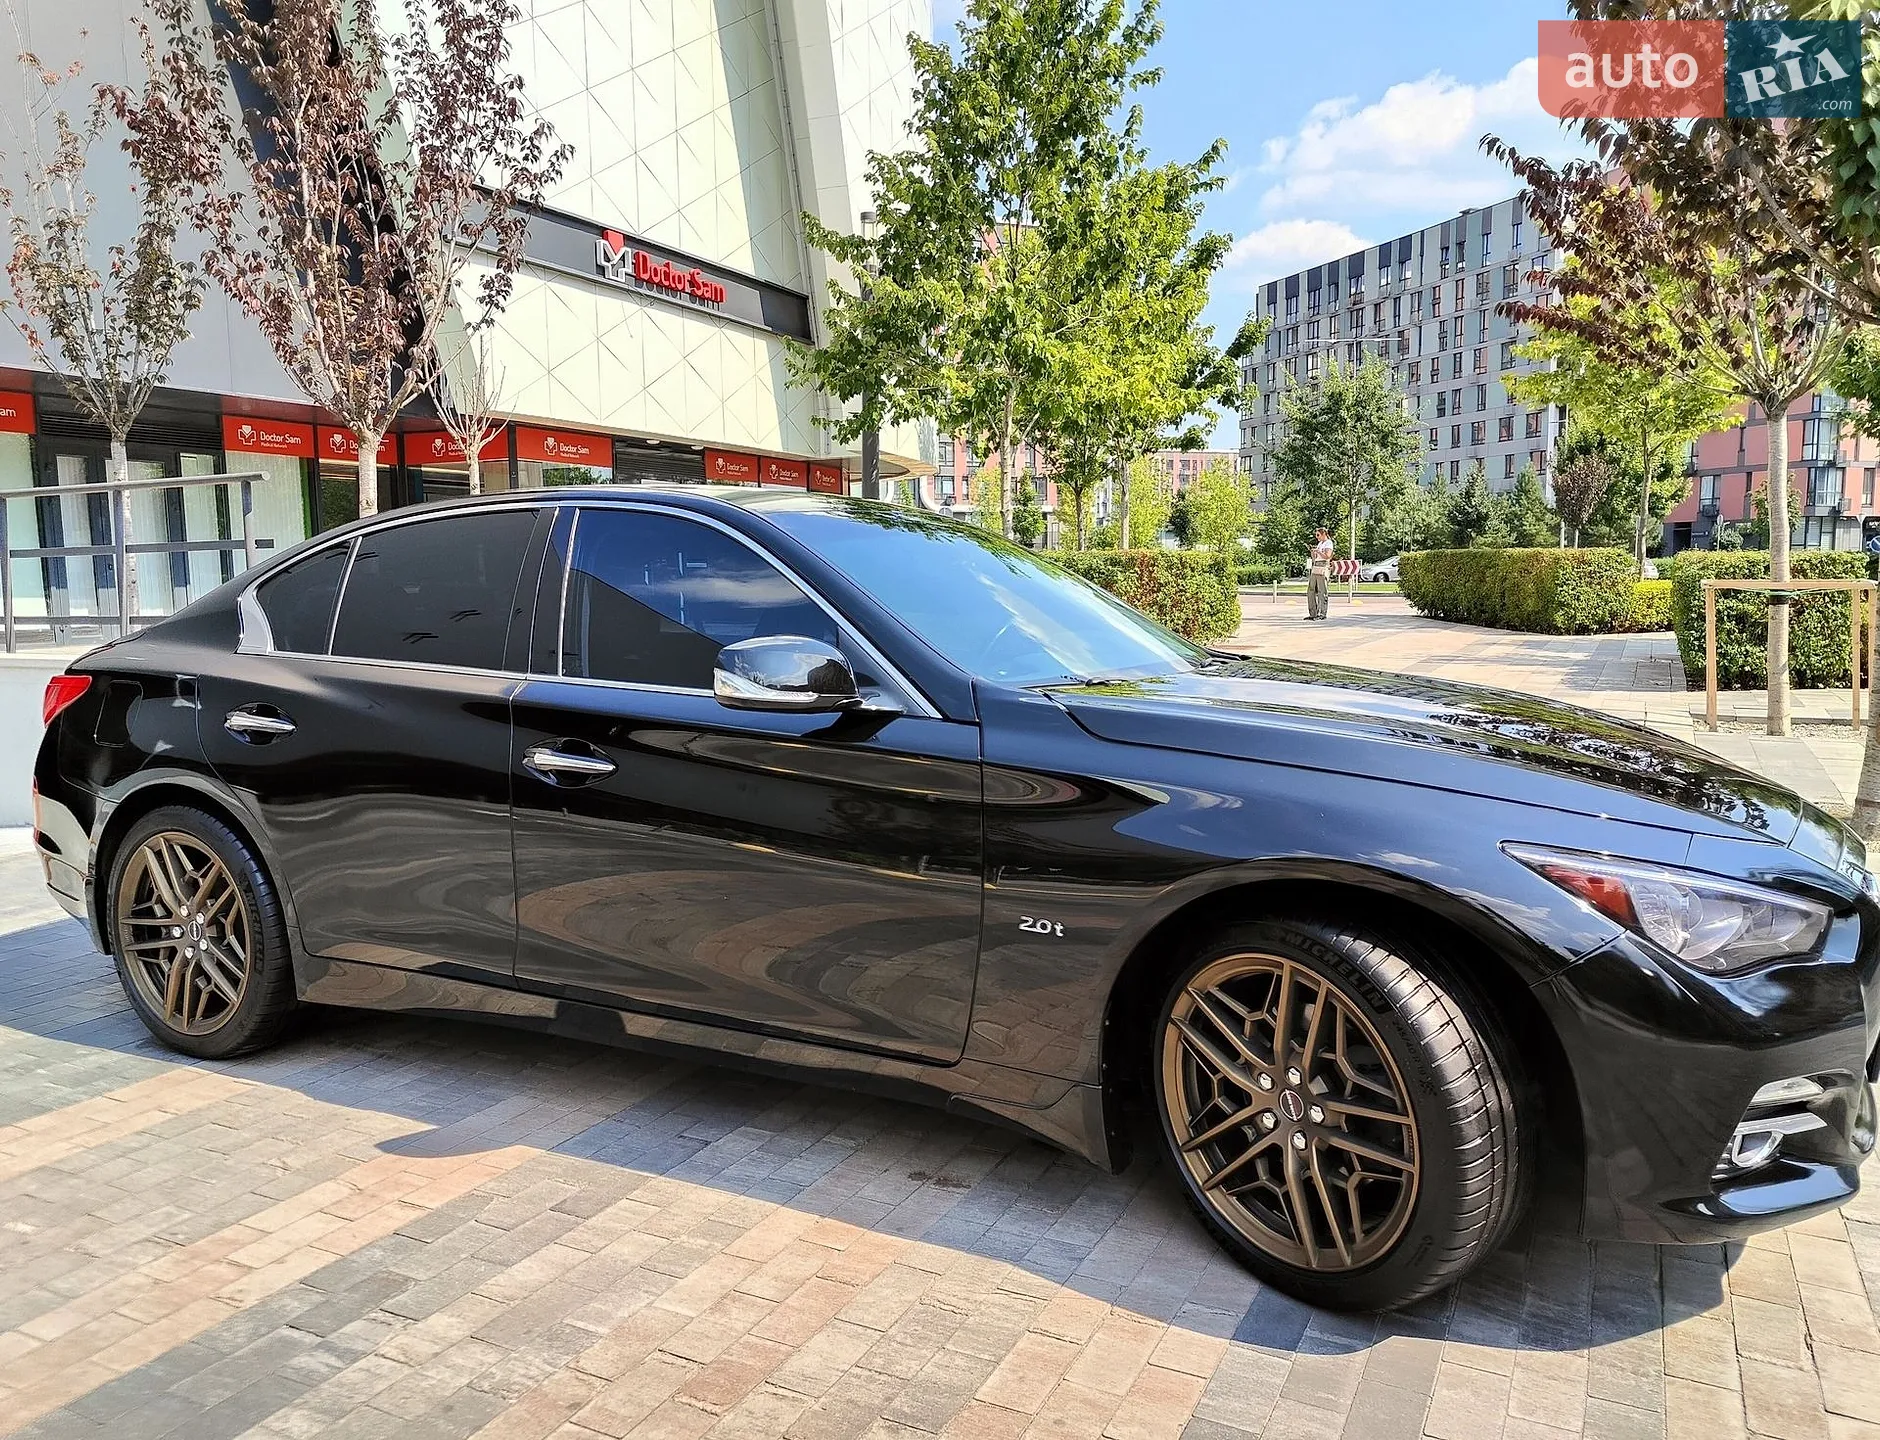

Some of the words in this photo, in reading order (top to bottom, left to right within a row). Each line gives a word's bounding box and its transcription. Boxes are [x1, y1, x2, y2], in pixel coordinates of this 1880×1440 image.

[633, 250, 690, 293] Doctor
[689, 268, 727, 304] Sam
[0, 408, 17, 418] am
[260, 431, 284, 443] Doctor
[285, 433, 302, 445] Sam
[560, 442, 577, 453] Doctor
[578, 445, 590, 455] Sam
[1284, 930, 1392, 1014] MICHELIN
